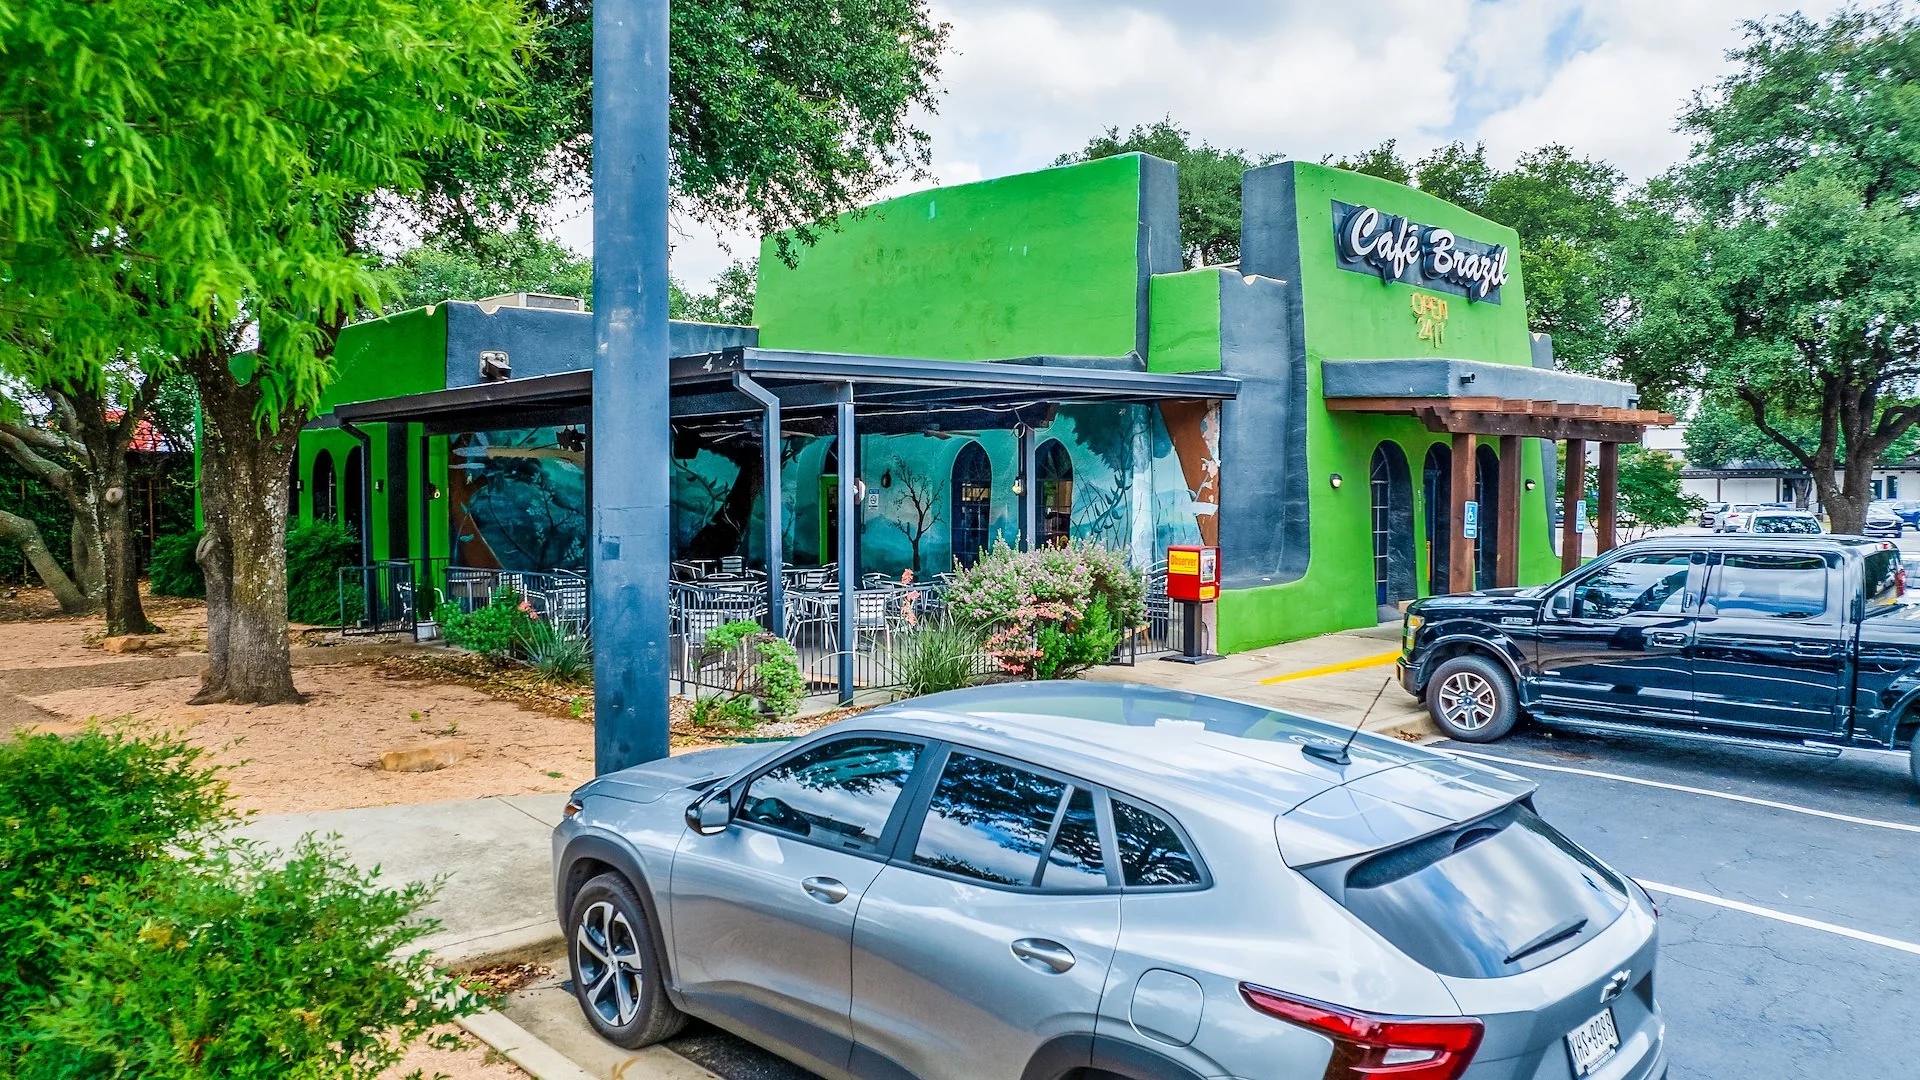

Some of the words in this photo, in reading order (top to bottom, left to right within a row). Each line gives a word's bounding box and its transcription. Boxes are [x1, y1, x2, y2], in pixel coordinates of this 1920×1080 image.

[1351, 208, 1420, 278] Café
[1430, 229, 1509, 297] Brazil
[1412, 292, 1448, 320] OPEN
[1171, 554, 1197, 567] Observer
